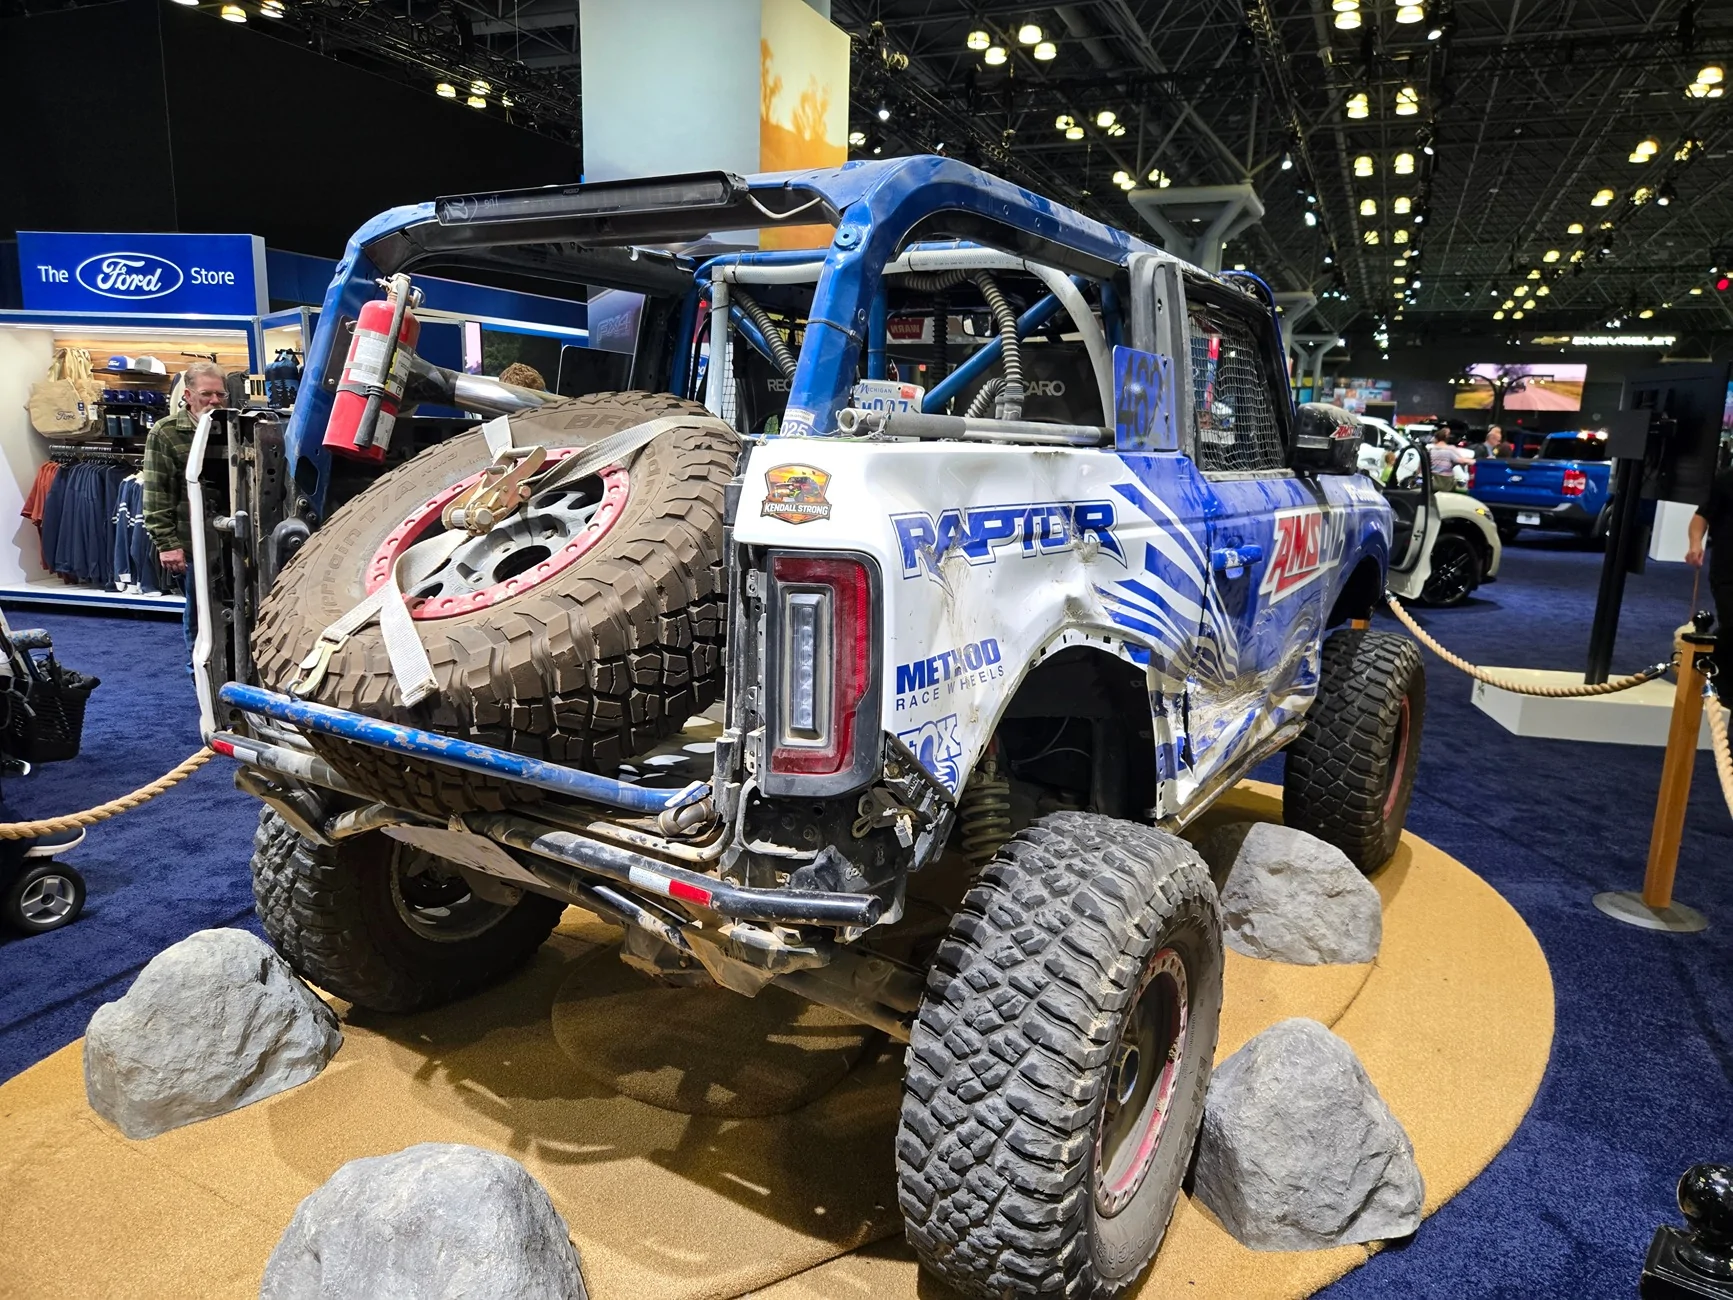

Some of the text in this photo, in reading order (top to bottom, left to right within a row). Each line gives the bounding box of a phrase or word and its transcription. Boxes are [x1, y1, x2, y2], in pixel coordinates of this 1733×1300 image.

[37, 258, 235, 292] The Ford Store
[1571, 336, 1677, 346] CHEVROLET
[780, 421, 808, 437] 025
[764, 502, 829, 516] KENDALL STRONG
[889, 499, 1128, 598] RAPTOR
[896, 638, 1002, 695] METHOD
[896, 664, 1005, 712] RACE WHEELS
